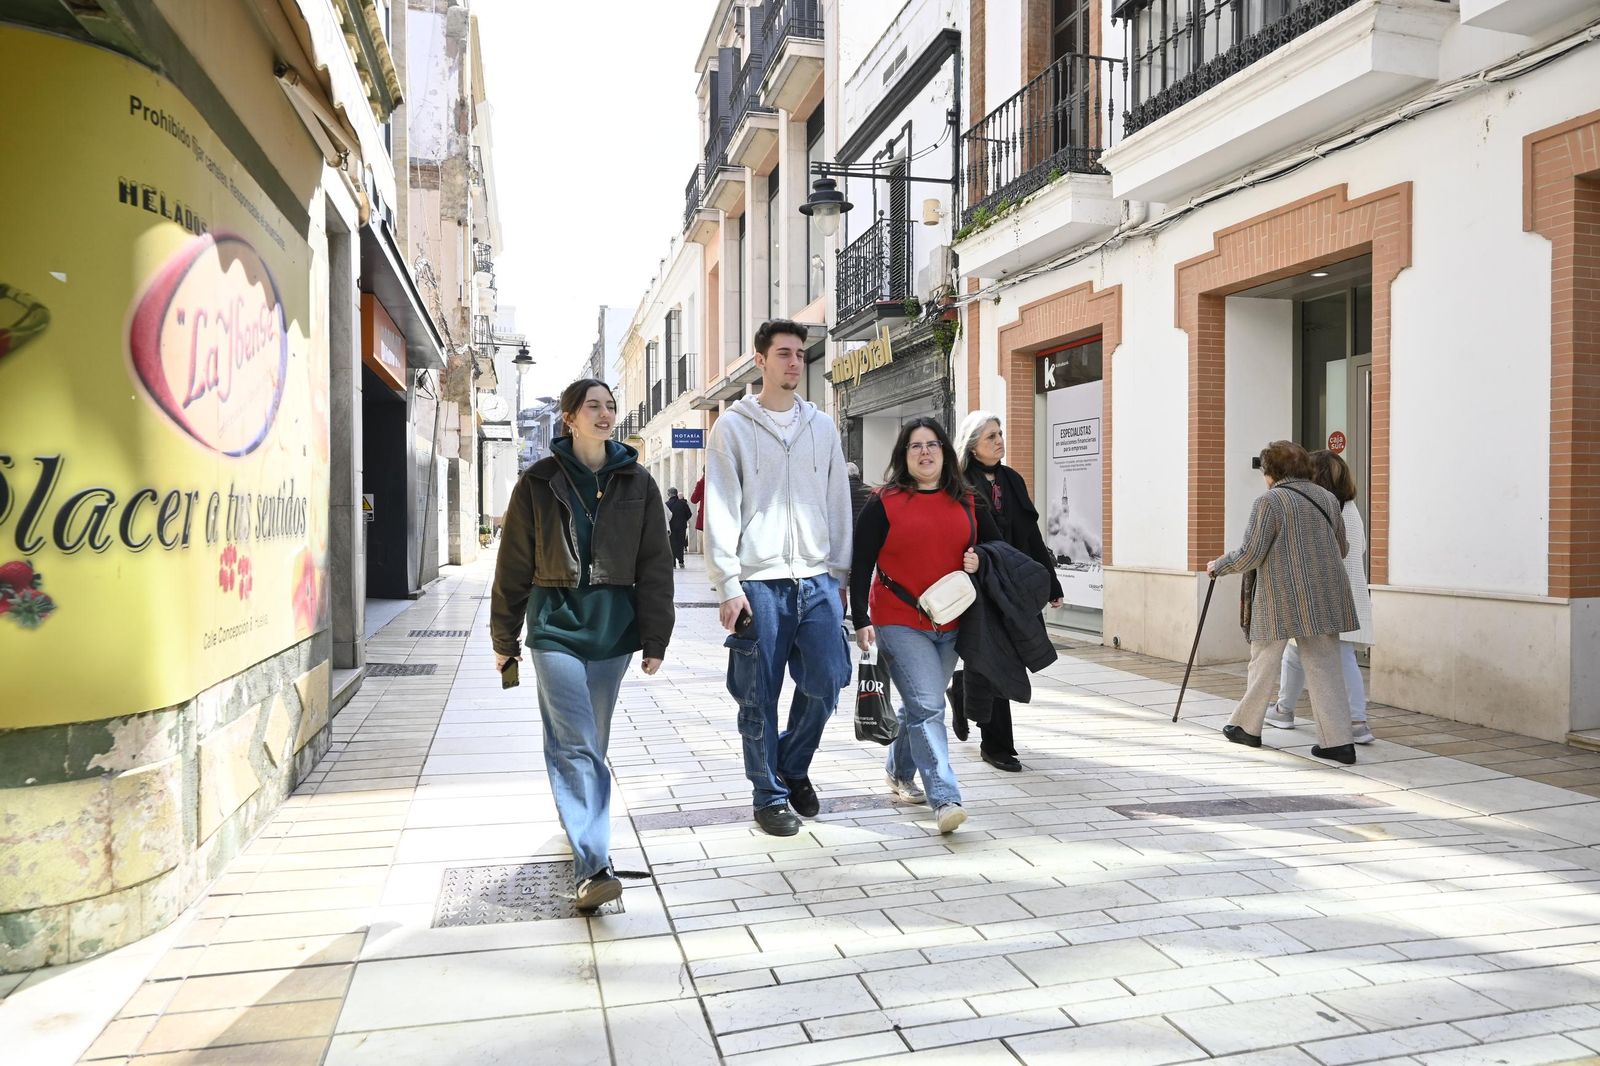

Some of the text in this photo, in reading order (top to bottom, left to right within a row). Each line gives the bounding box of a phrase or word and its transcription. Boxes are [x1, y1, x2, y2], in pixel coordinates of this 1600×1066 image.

[129, 94, 191, 149] Prohibido
[118, 176, 208, 237] HELADOS
[830, 325, 893, 387] mayoral
[1060, 425, 1091, 439] ESPECIALISTAS
[1329, 434, 1343, 445] caja
[205, 491, 220, 545] a
[225, 482, 252, 543] tus
[255, 478, 307, 541] sentidos
